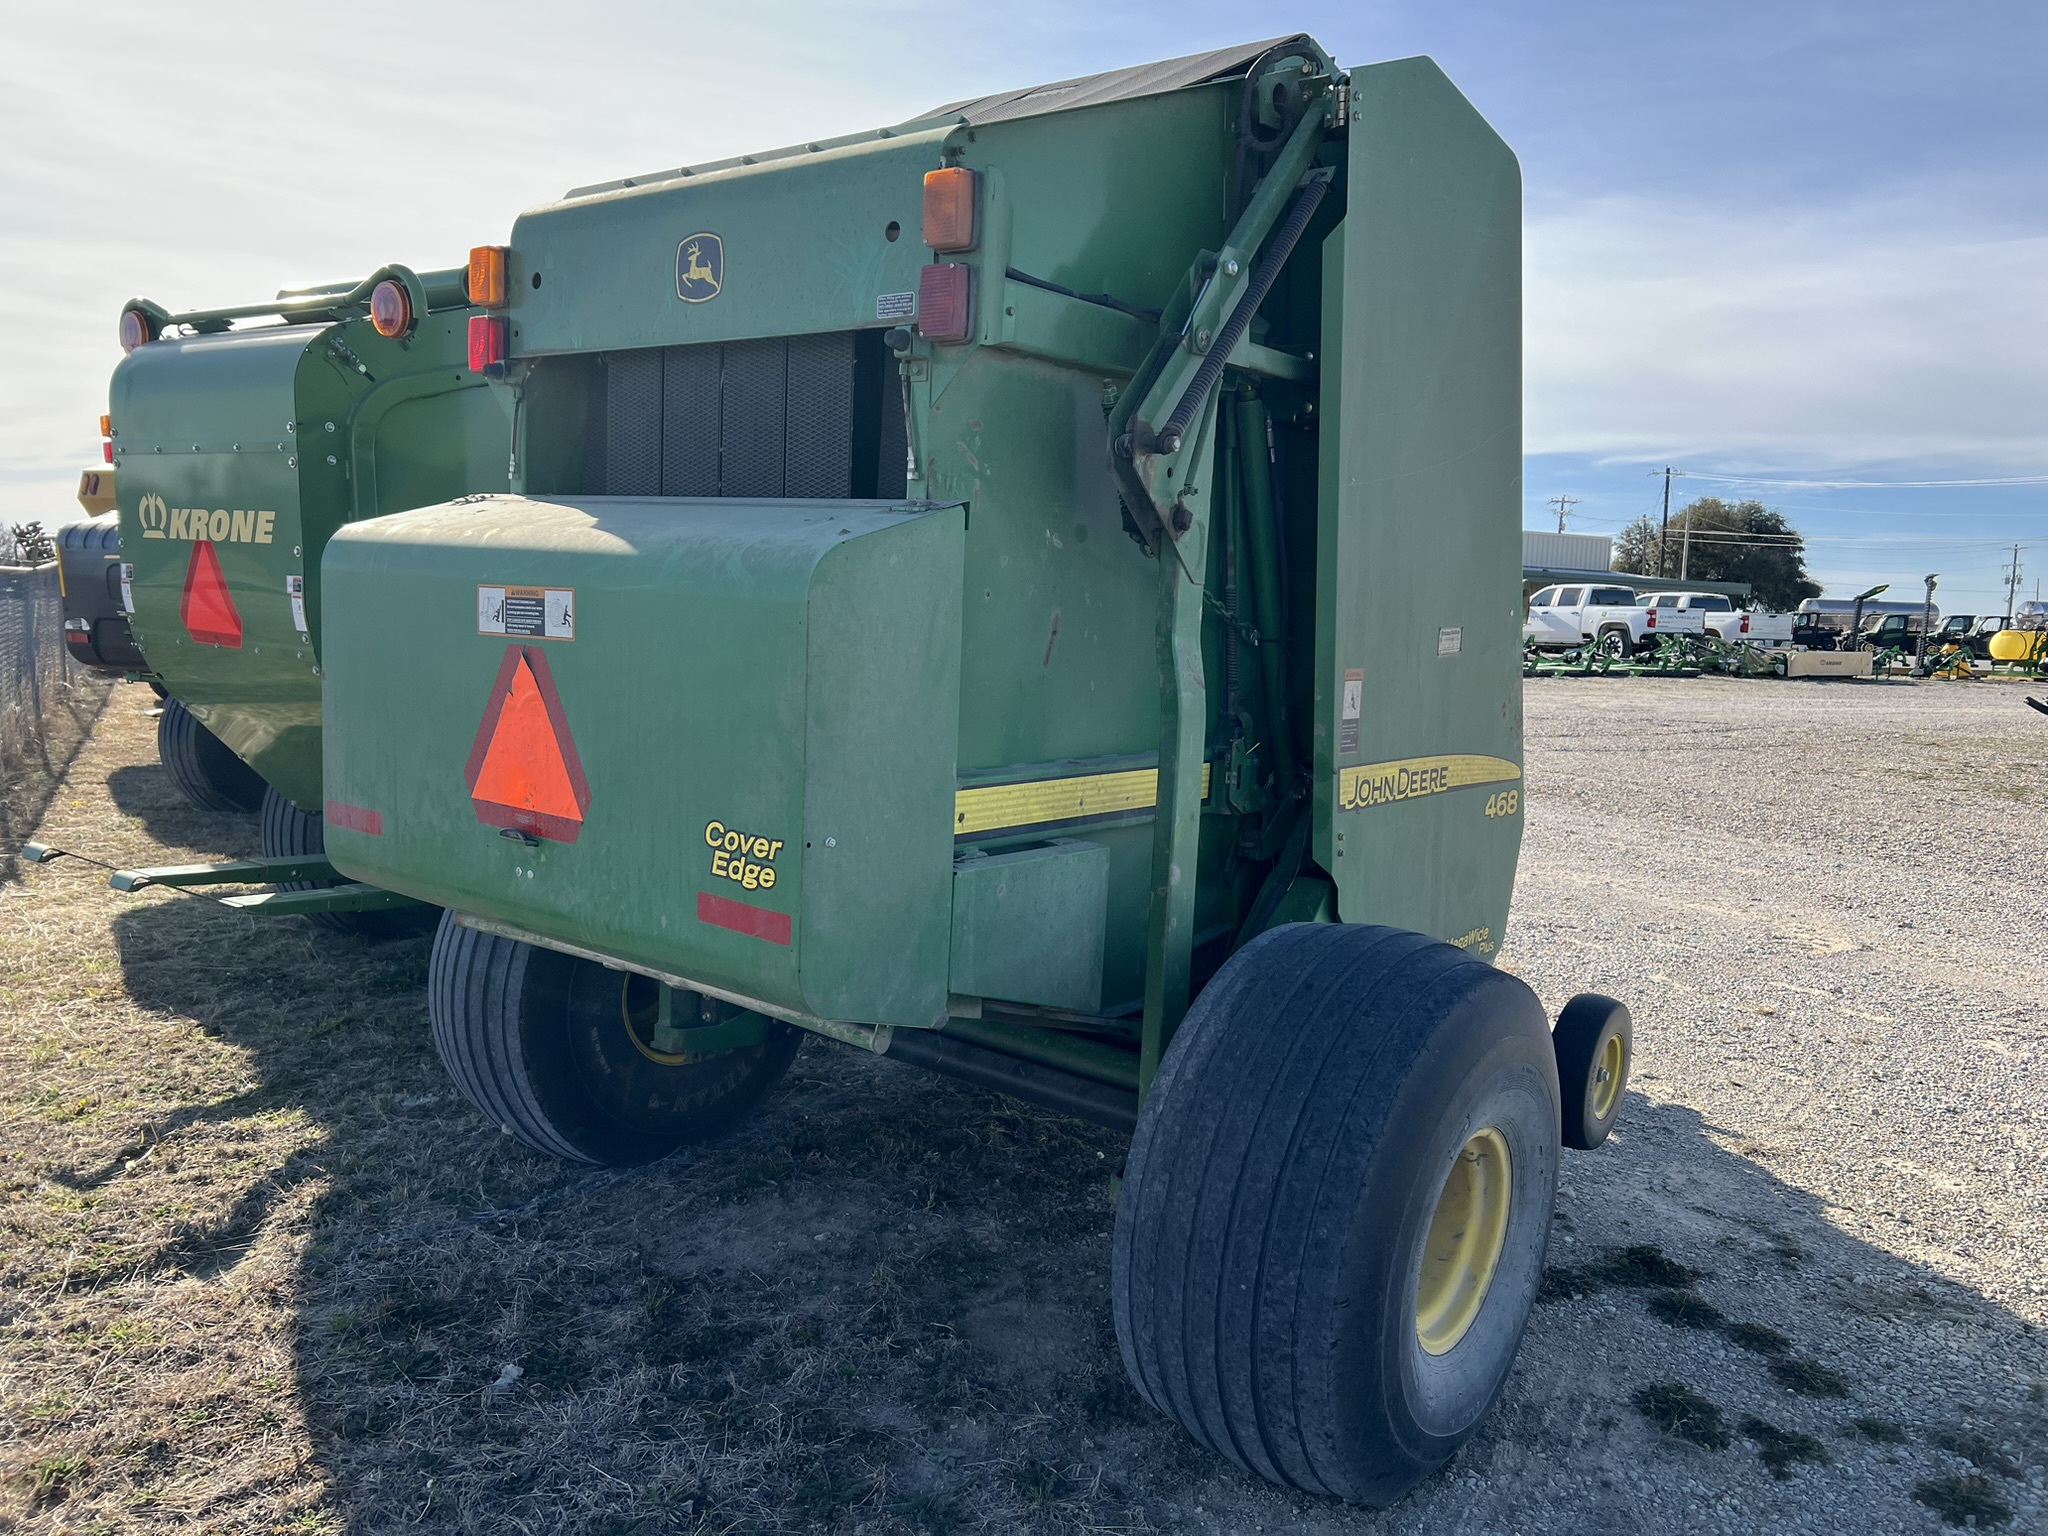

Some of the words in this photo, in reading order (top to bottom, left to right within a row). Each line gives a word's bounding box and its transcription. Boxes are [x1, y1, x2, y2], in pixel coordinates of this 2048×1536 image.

[169, 508, 276, 545] KRONE
[513, 589, 539, 597] WARNING
[1347, 774, 1396, 809] JOHN
[1395, 766, 1450, 800] DEERE
[1484, 789, 1520, 819] 468
[705, 820, 783, 861] Cover
[711, 850, 776, 889] Edge
[1478, 940, 1495, 955] Plus
